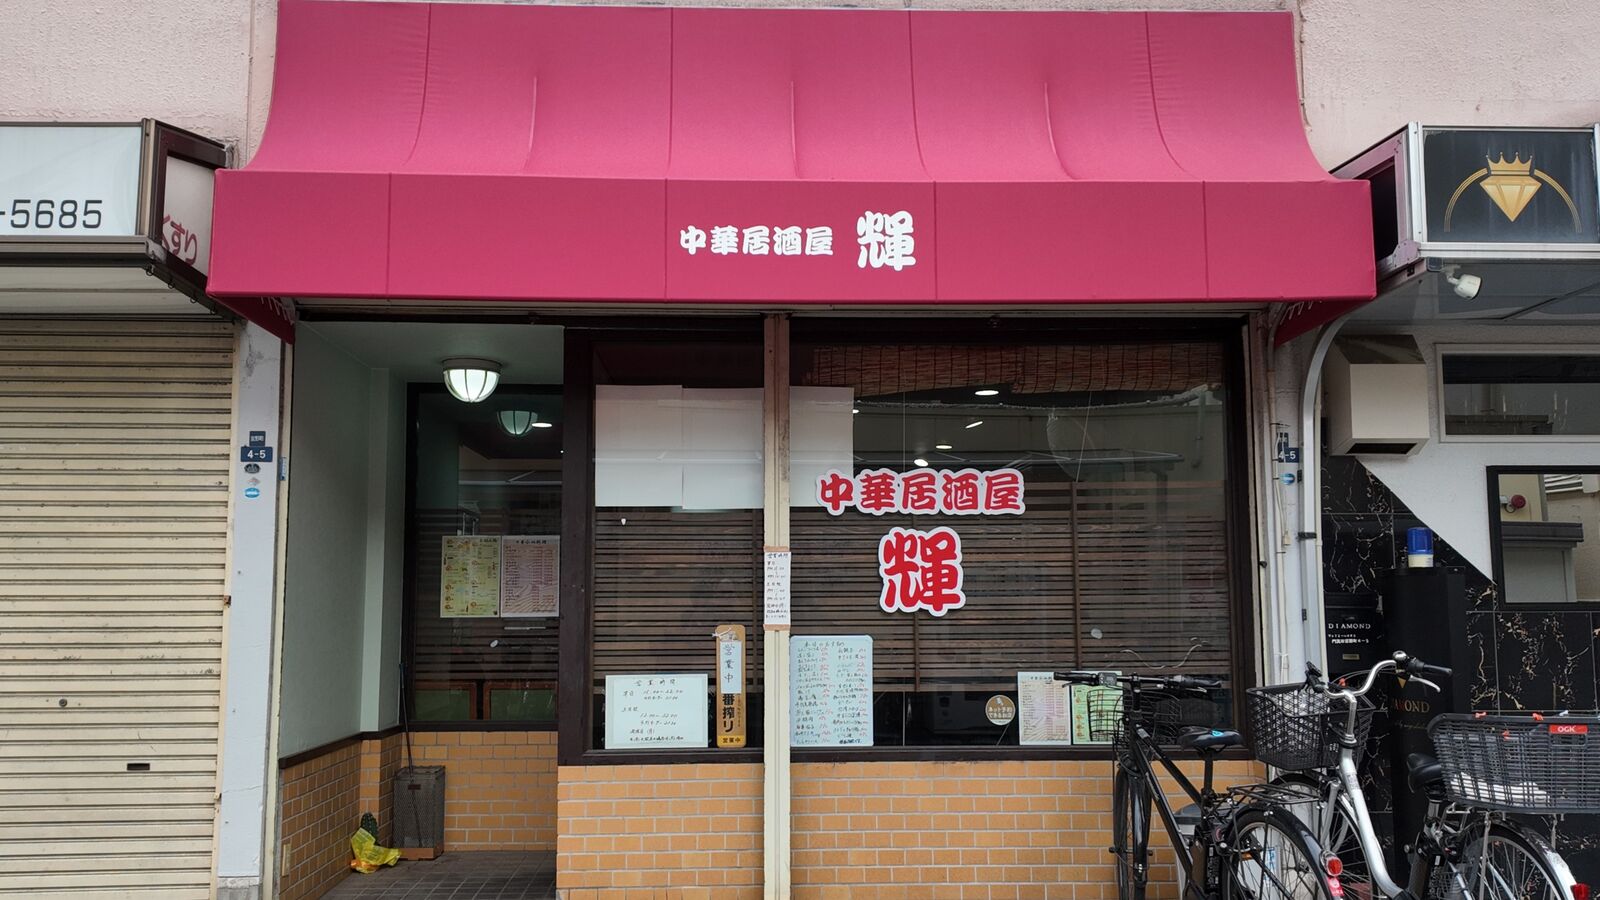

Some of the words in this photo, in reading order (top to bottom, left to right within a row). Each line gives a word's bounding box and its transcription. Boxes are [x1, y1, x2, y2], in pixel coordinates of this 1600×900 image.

[679, 225, 834, 255] 中華居酒屋
[856, 210, 916, 272] 輝
[247, 449, 266, 459] 4-5
[817, 470, 1025, 514] 中華居酒屋
[881, 528, 964, 615] 輝
[723, 643, 735, 684] 営業中
[1557, 725, 1577, 733] OGK
